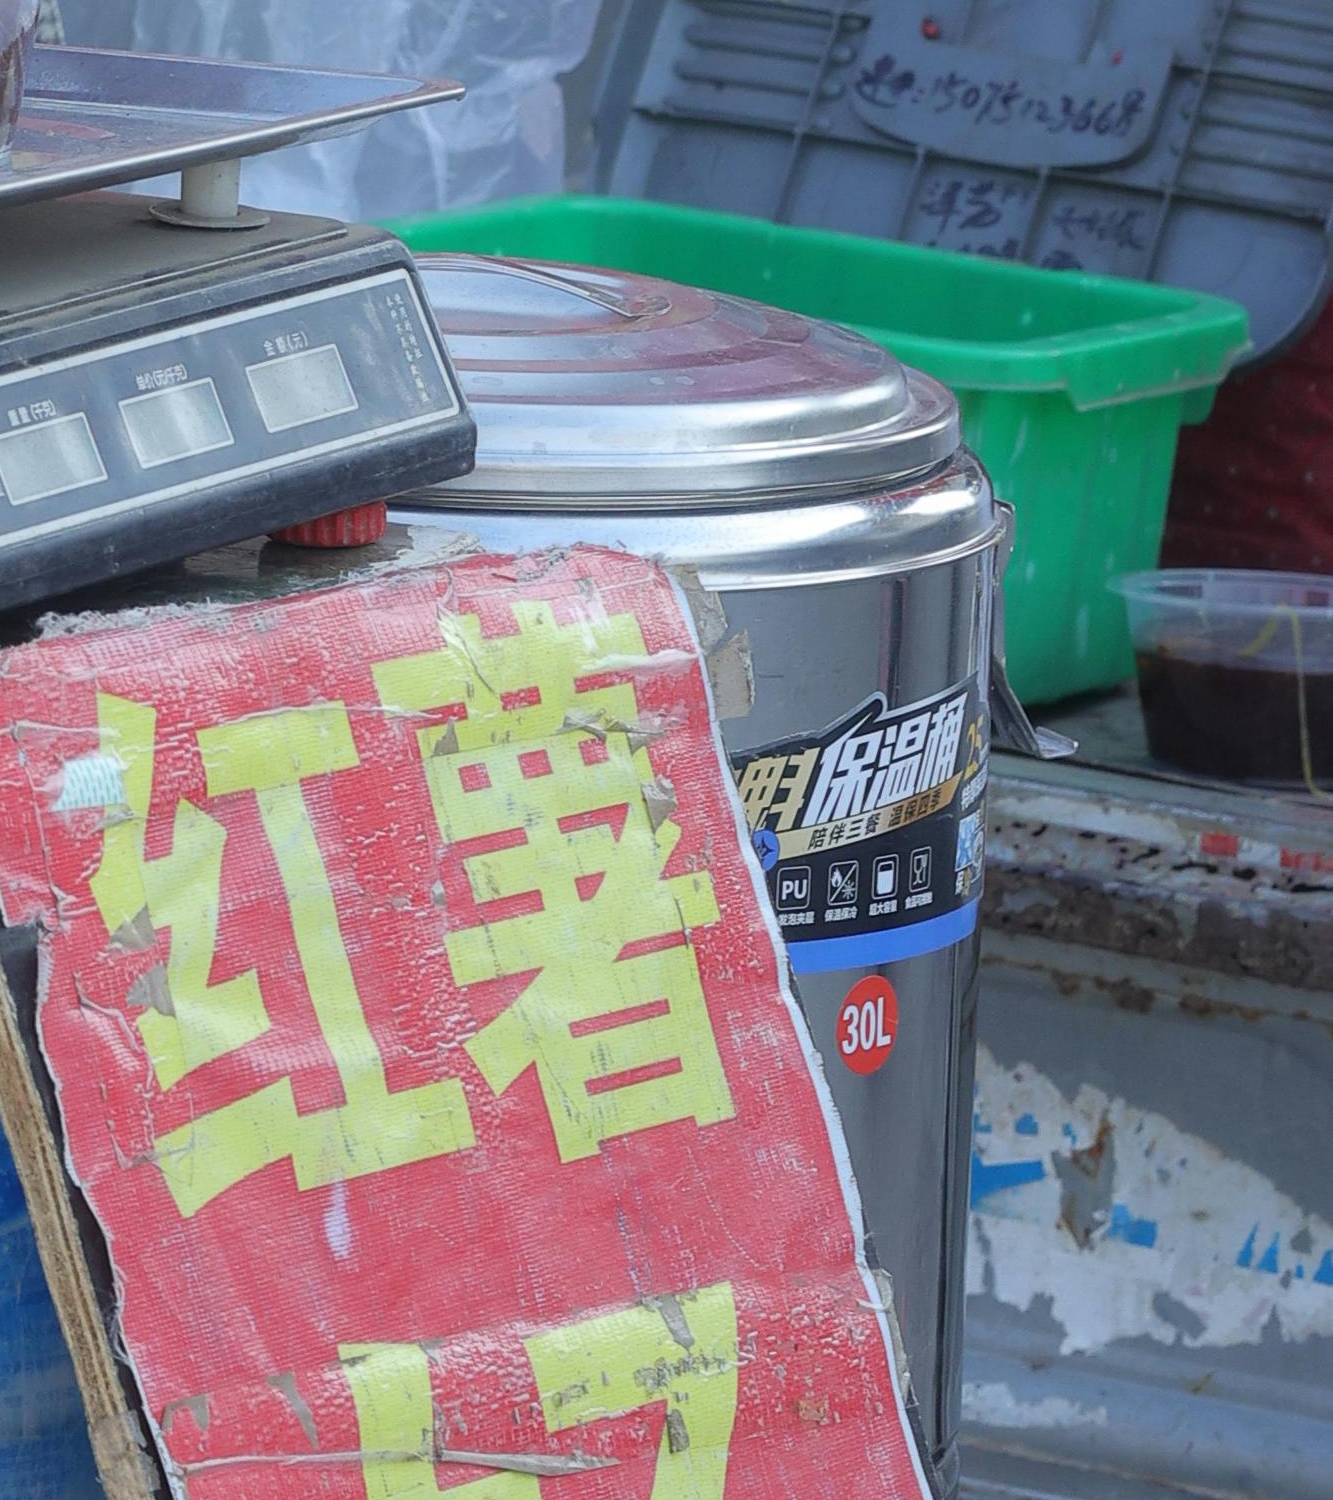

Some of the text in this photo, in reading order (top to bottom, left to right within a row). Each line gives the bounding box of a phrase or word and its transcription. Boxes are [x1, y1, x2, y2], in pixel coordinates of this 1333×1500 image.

[735, 693, 969, 834] 魁保温桶
[807, 811, 882, 851] 陪伴三餐
[90, 598, 749, 1218] 红薯
[781, 878, 808, 901] PU
[841, 996, 893, 1056] 30L
